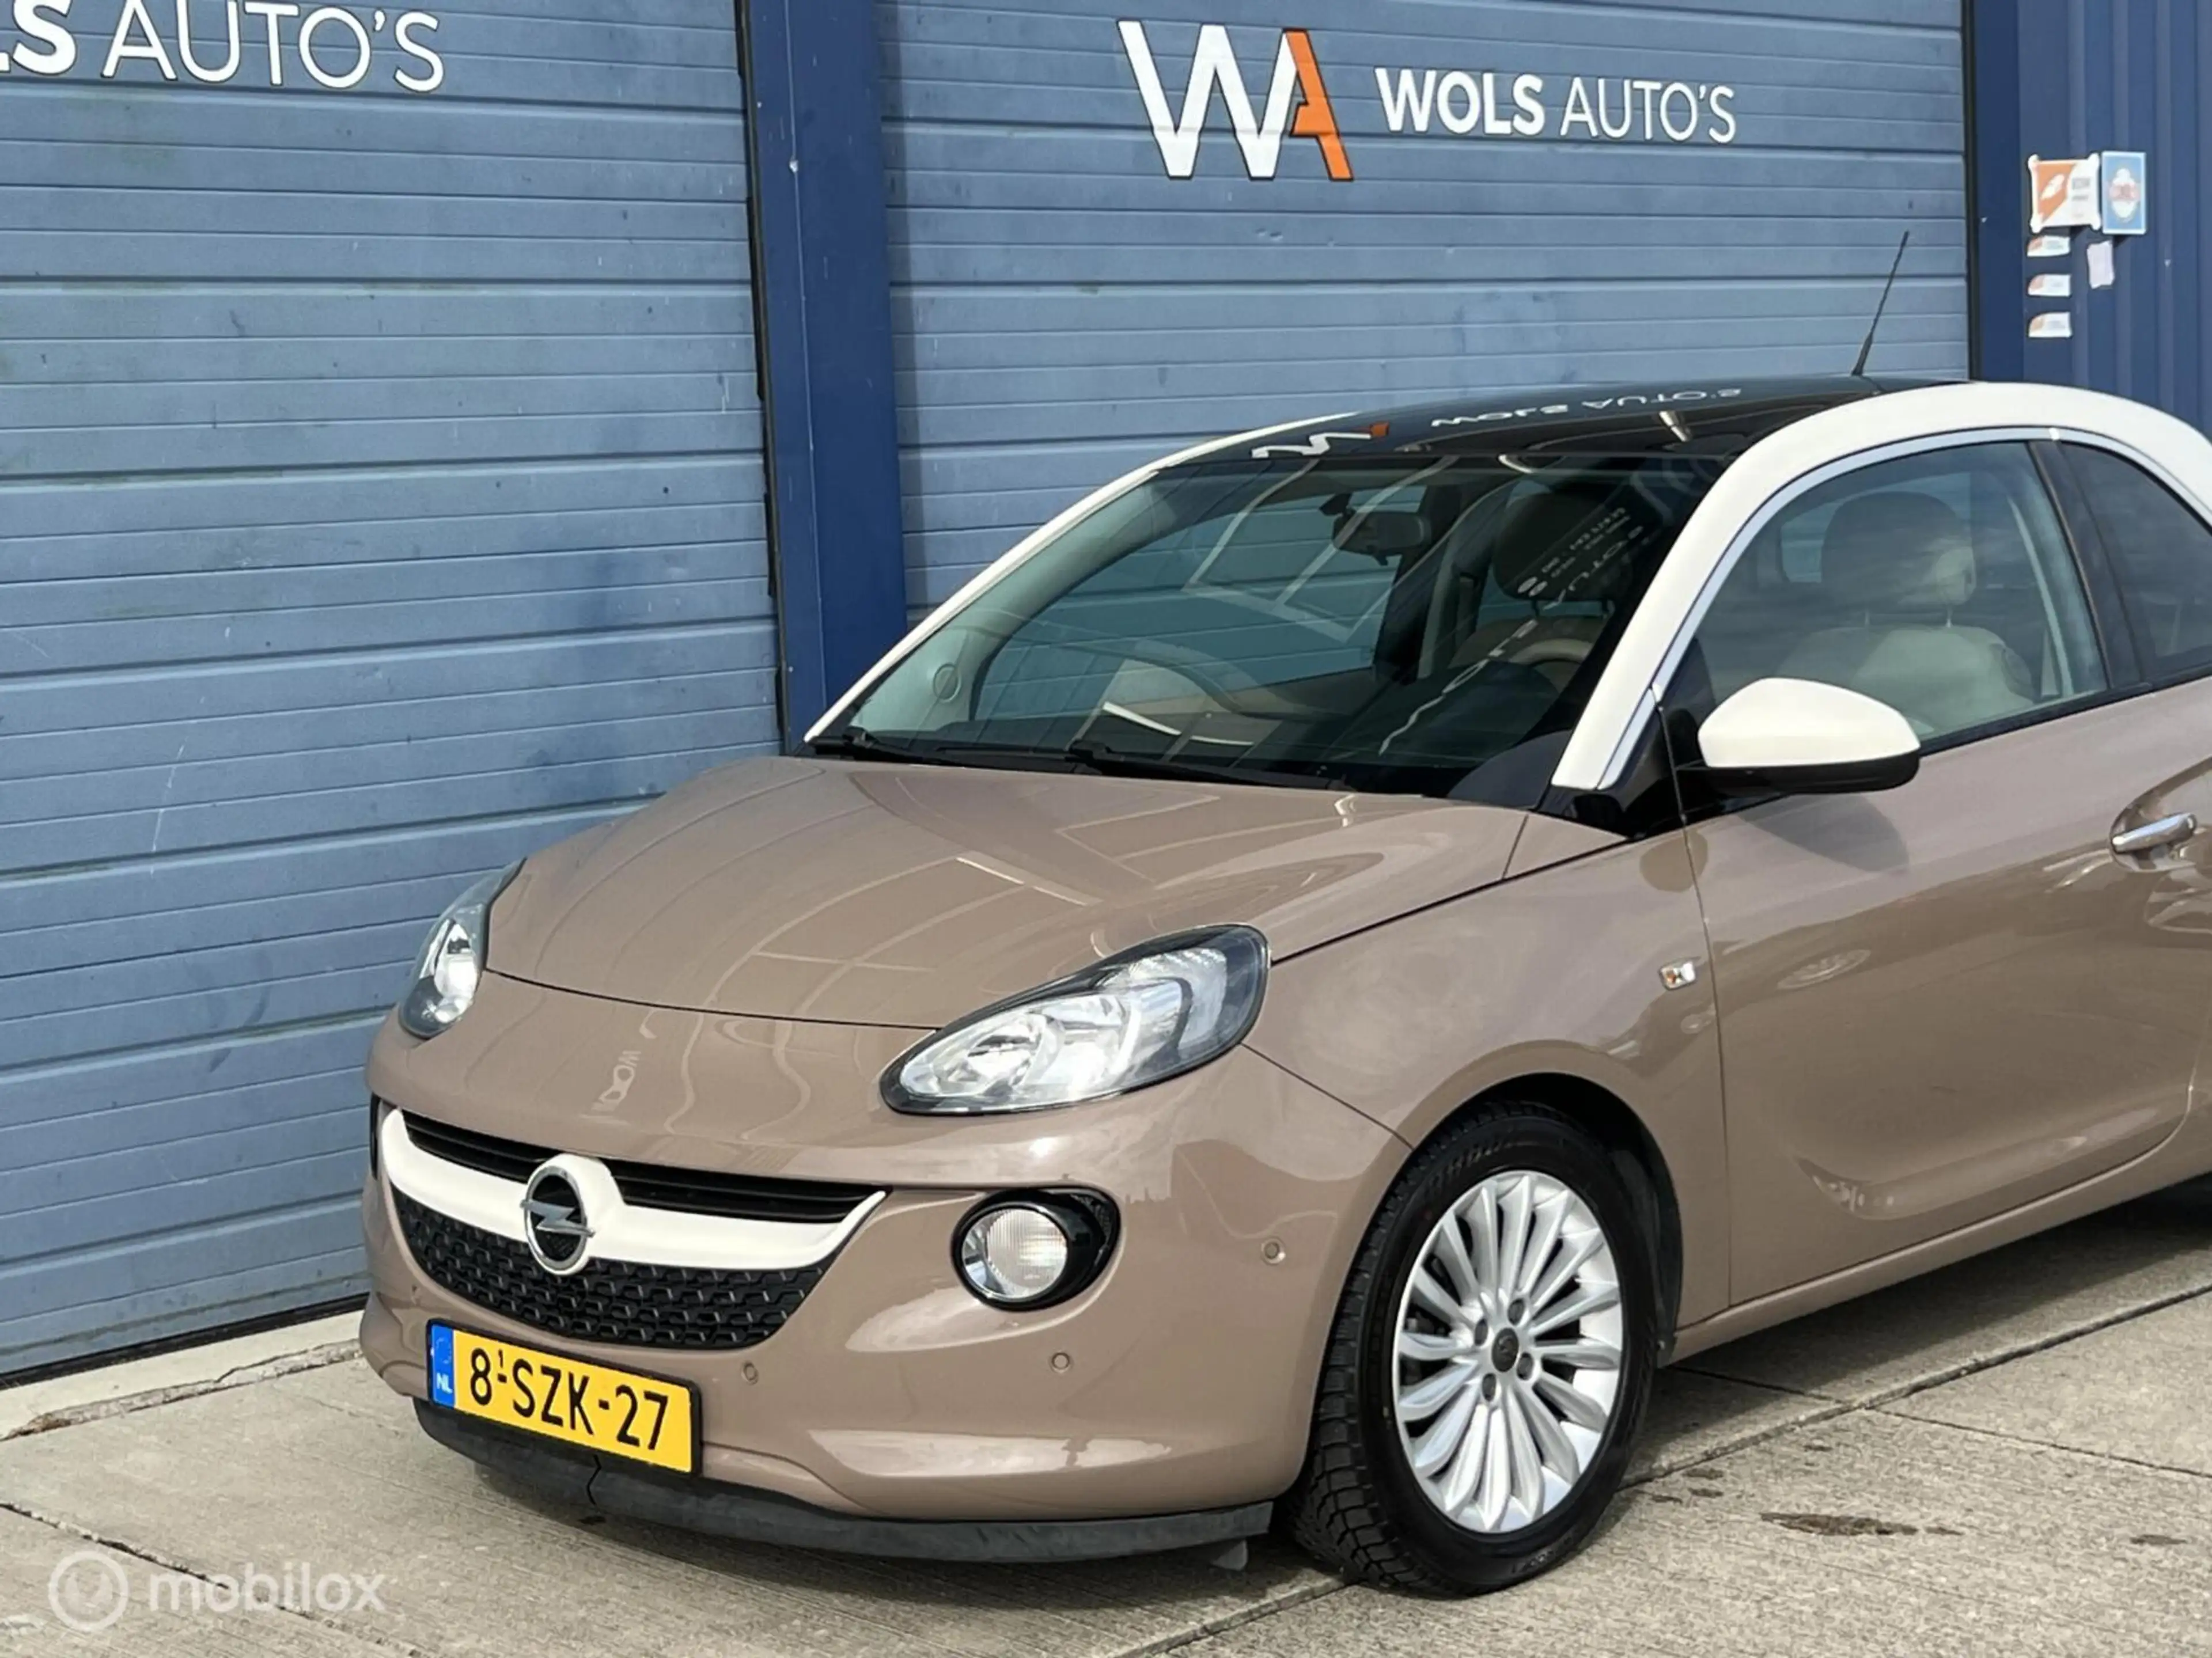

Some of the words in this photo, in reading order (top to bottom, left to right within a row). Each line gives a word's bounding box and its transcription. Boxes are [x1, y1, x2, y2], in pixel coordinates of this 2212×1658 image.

[0, 0, 76, 75] S
[101, 0, 444, 92] AUTO'S
[1117, 21, 1354, 181] WA
[1374, 67, 1546, 136] WOLS
[1560, 77, 1736, 143] AUTO'S
[436, 1372, 453, 1394] NL
